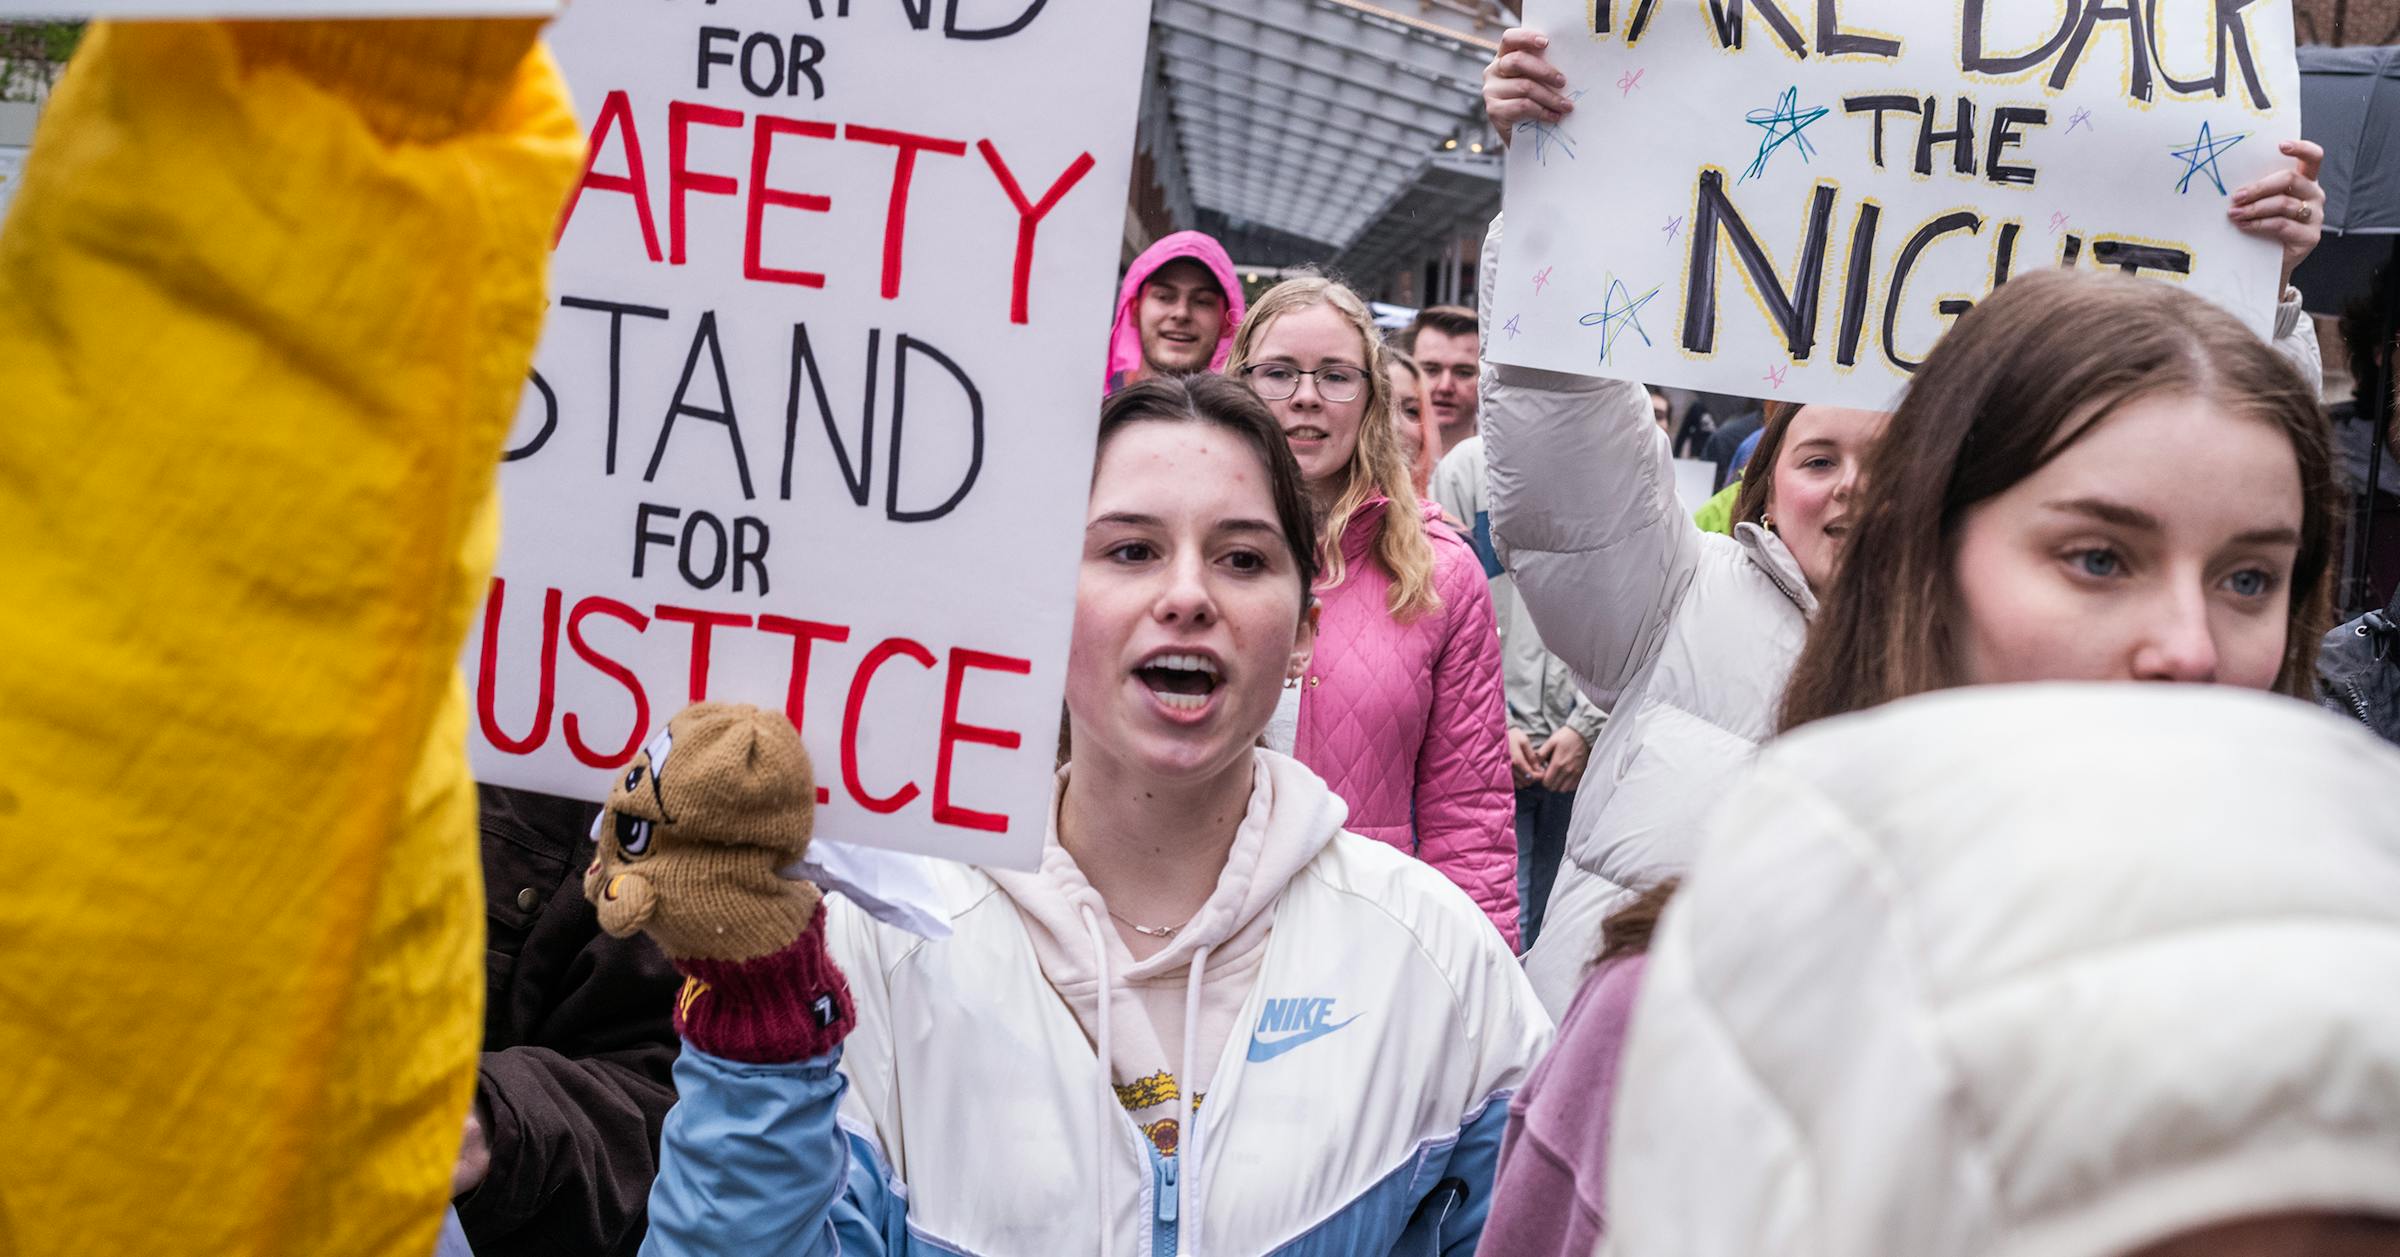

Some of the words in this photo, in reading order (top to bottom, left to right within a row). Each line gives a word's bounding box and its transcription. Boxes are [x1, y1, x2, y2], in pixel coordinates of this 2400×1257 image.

[697, 26, 825, 100] FOR
[1843, 95, 2047, 185] THE
[553, 90, 1096, 324] AFETY
[632, 502, 770, 597] FOR
[477, 576, 1032, 834] USTICE
[1257, 998, 1337, 1033] NIKE
